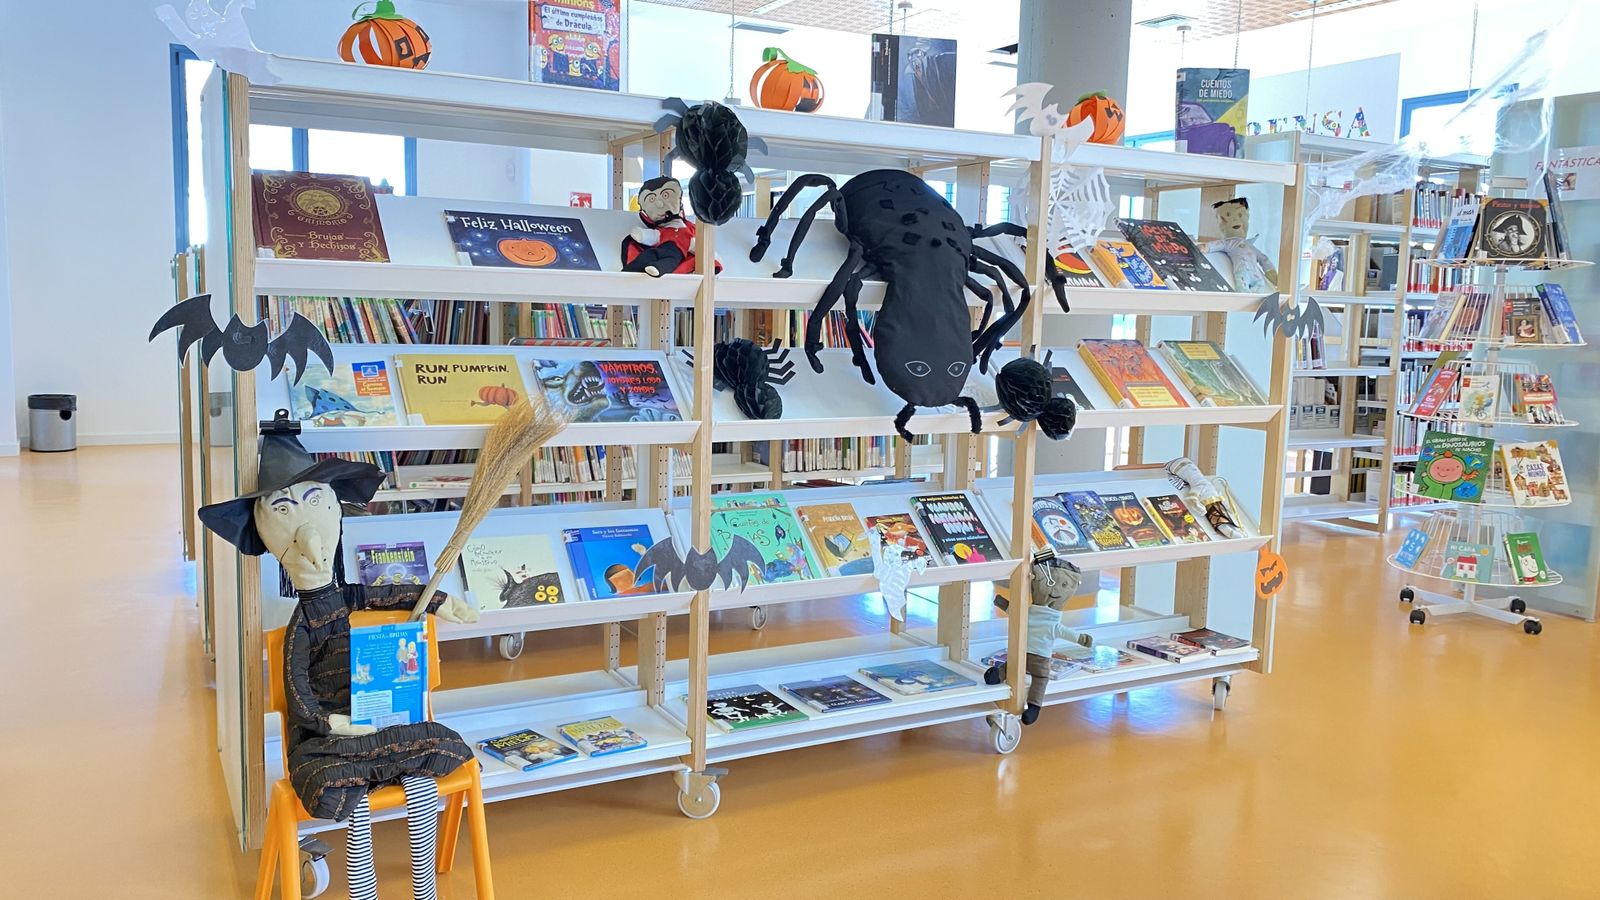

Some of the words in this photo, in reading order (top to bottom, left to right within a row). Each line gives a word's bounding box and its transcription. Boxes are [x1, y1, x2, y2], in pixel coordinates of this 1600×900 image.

[551, 7, 569, 16] último
[1200, 79, 1232, 89] CUENTOS
[1198, 89, 1209, 98] DE
[1210, 89, 1233, 99] MIEDO
[459, 216, 498, 231] Feliz
[500, 218, 573, 234] Halloween
[308, 231, 344, 242] Brujas
[309, 240, 357, 253] Hechizos
[600, 363, 658, 375] VAMPIROS,
[417, 375, 447, 384] RUN
[371, 547, 415, 565] Frankenstein
